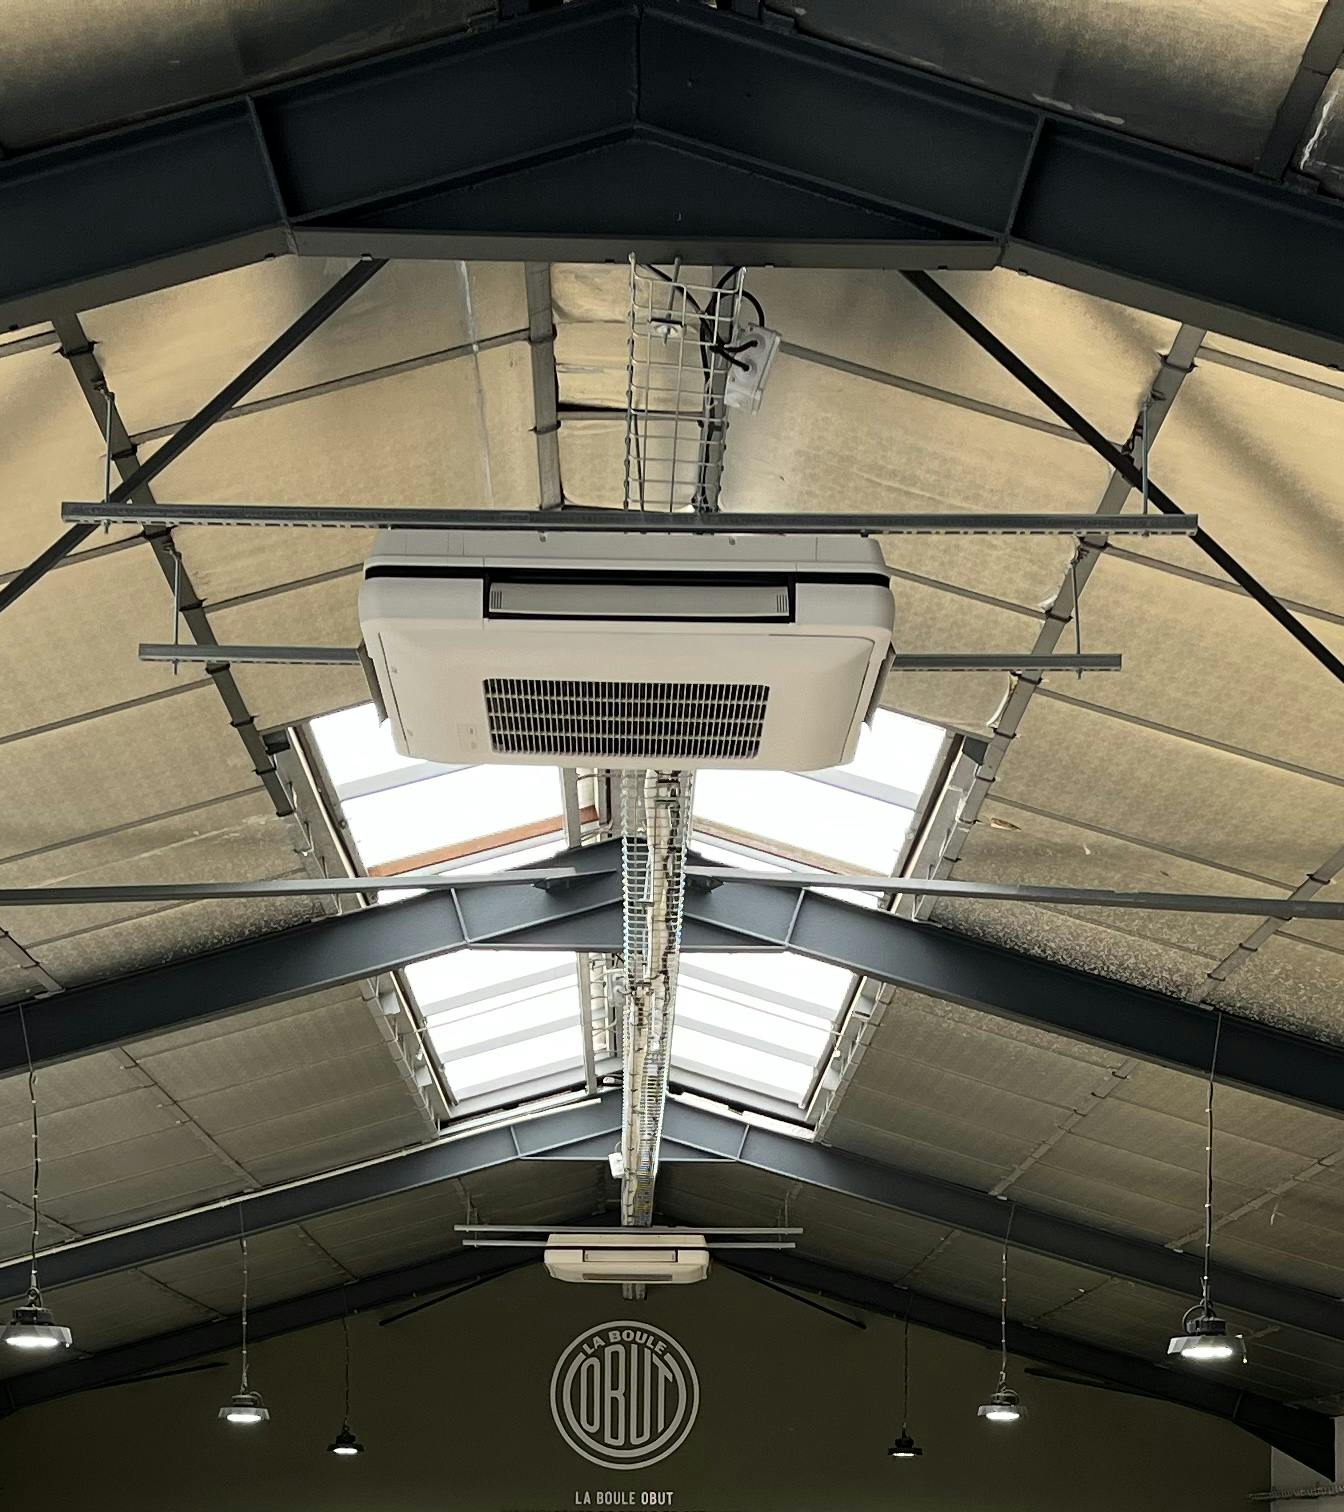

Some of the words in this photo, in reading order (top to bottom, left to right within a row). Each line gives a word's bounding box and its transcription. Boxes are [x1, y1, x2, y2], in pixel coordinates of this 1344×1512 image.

[582, 1335, 606, 1355] LA
[608, 1329, 668, 1355] BOULE
[580, 1343, 673, 1446] OBUT
[575, 1491, 591, 1505] LA
[596, 1491, 636, 1505] BOULE
[641, 1491, 674, 1505] OBUT
